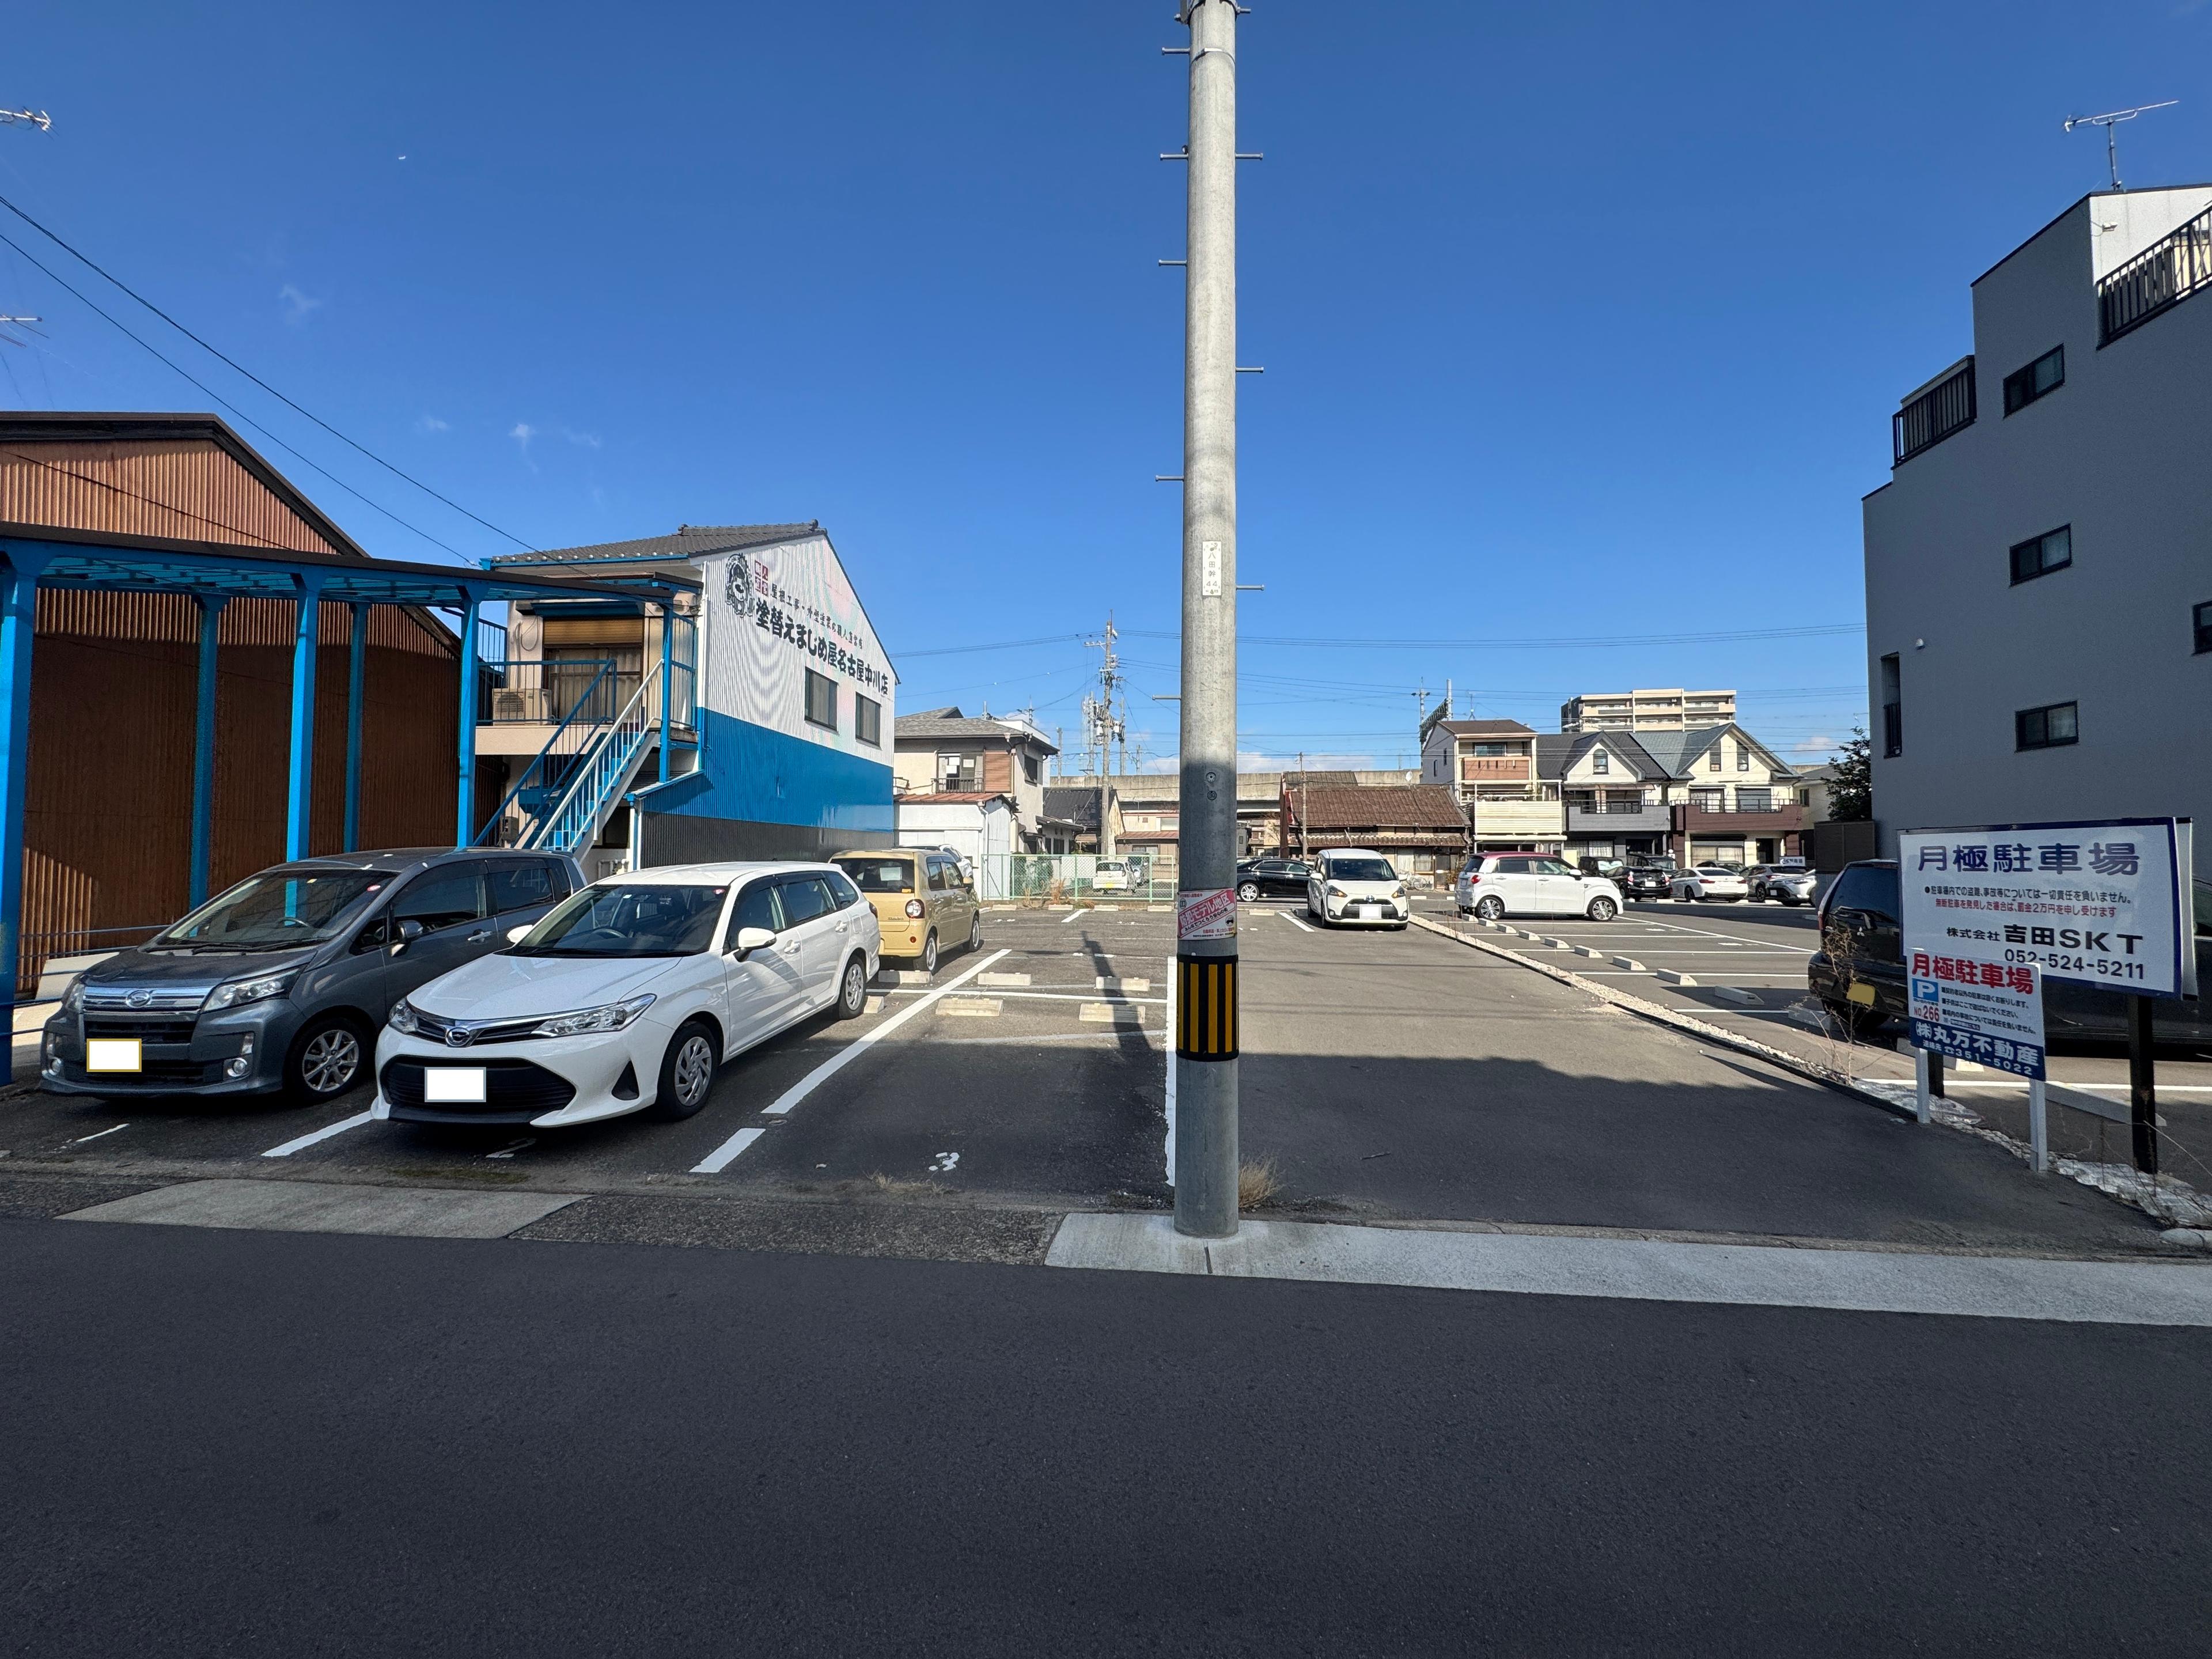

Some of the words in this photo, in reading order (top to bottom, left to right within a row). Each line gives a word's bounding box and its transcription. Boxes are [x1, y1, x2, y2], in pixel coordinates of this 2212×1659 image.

[756, 597, 889, 695] 塗替えまじめ屋名古屋中川店
[1918, 842, 2140, 876] 月極駐車場
[1179, 893, 1231, 927] 防犯モデル地区
[1930, 885, 2131, 904] 駐車場内での盗難、事故等については一切責任を負いません。
[1946, 926, 2001, 942] 株式会社
[2003, 924, 2143, 955] 吉田SKT
[1911, 953, 2034, 995] 月極駐車場
[2005, 948, 2145, 980] 052-524-5211
[1916, 981, 1936, 998] P
[1923, 1040, 1942, 1052] 連絡先
